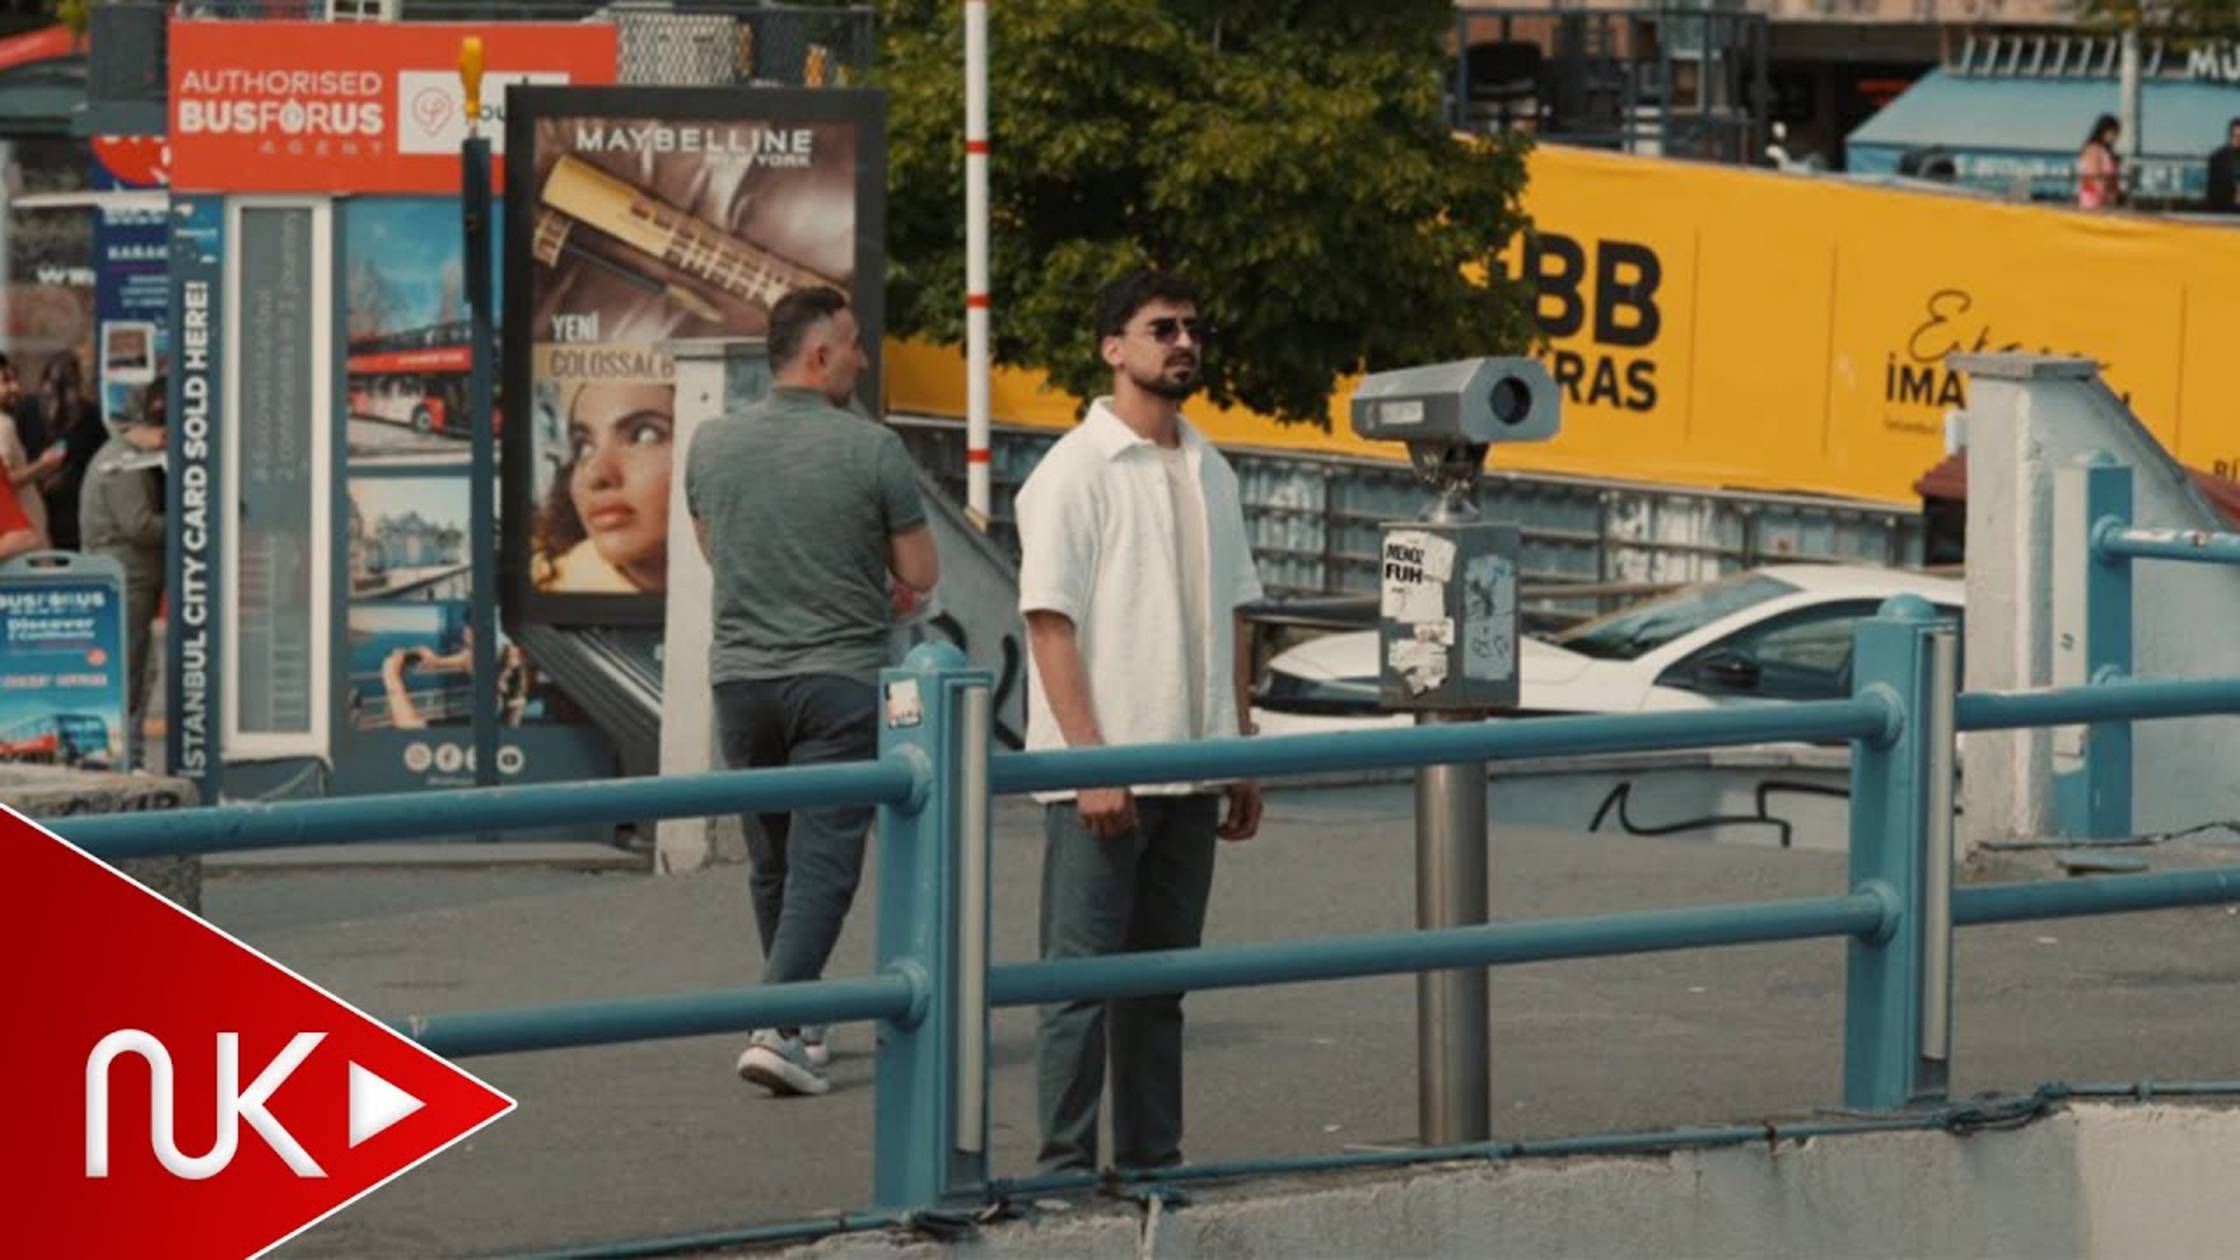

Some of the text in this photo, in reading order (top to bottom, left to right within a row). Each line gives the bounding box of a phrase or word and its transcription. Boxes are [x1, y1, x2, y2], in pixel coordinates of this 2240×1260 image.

[180, 70, 383, 95] AUTHORISED
[178, 98, 383, 134] BUSFORUS
[576, 128, 813, 152] MAYBELLINE
[757, 153, 812, 168] YORK
[184, 280, 208, 369] HERE!
[551, 310, 600, 342] YENİ
[551, 349, 657, 379] COLOSSAL
[183, 376, 208, 460] SOLD
[182, 464, 208, 551] CARD
[181, 556, 207, 625] CITY
[178, 633, 207, 778] İSTANBUL
